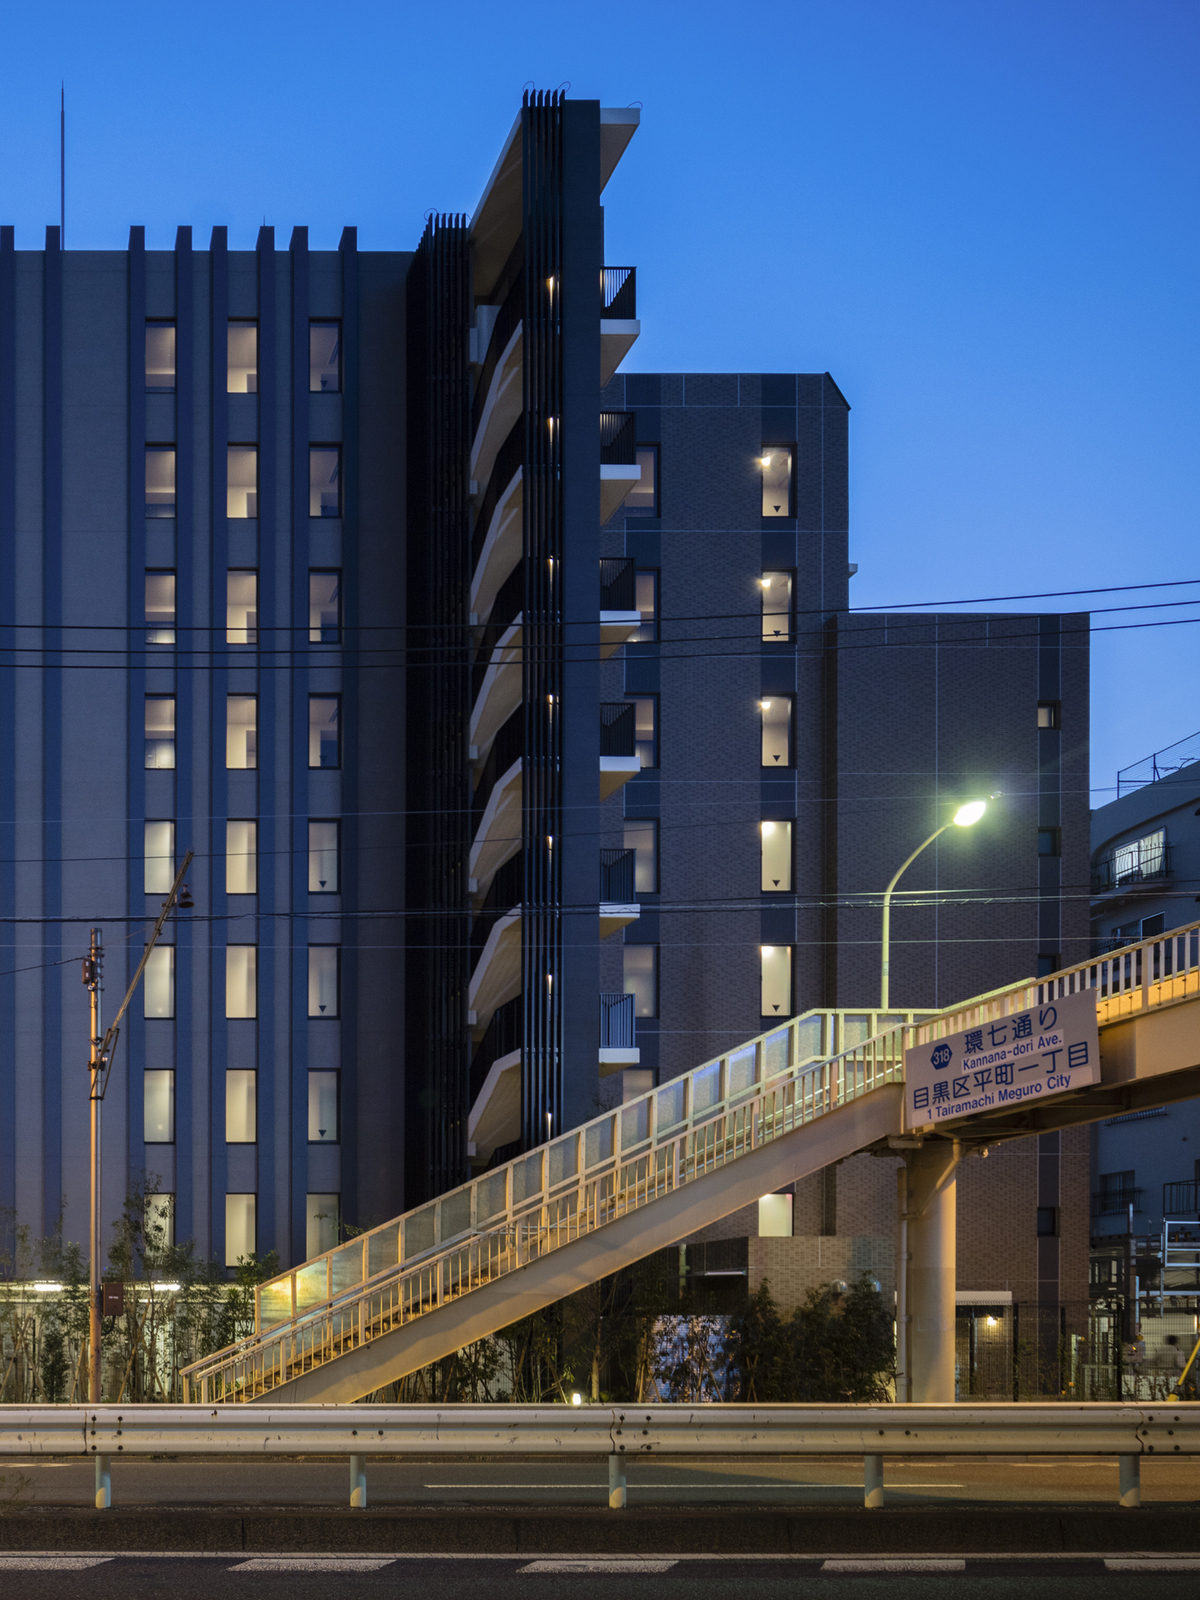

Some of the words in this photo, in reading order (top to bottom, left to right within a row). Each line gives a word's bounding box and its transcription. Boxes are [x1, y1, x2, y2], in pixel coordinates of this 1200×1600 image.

[963, 1039, 1034, 1071] Kannana-dori
[1037, 1034, 1062, 1050] Ave.
[964, 1006, 1058, 1054] 環七通り
[913, 1041, 1089, 1110] 目黒区平町一丁目
[932, 1050, 950, 1065] 318
[927, 1109, 932, 1120] 1
[935, 1092, 995, 1118] Tairamachi
[998, 1081, 1043, 1103] Meguro
[1046, 1074, 1071, 1090] City
